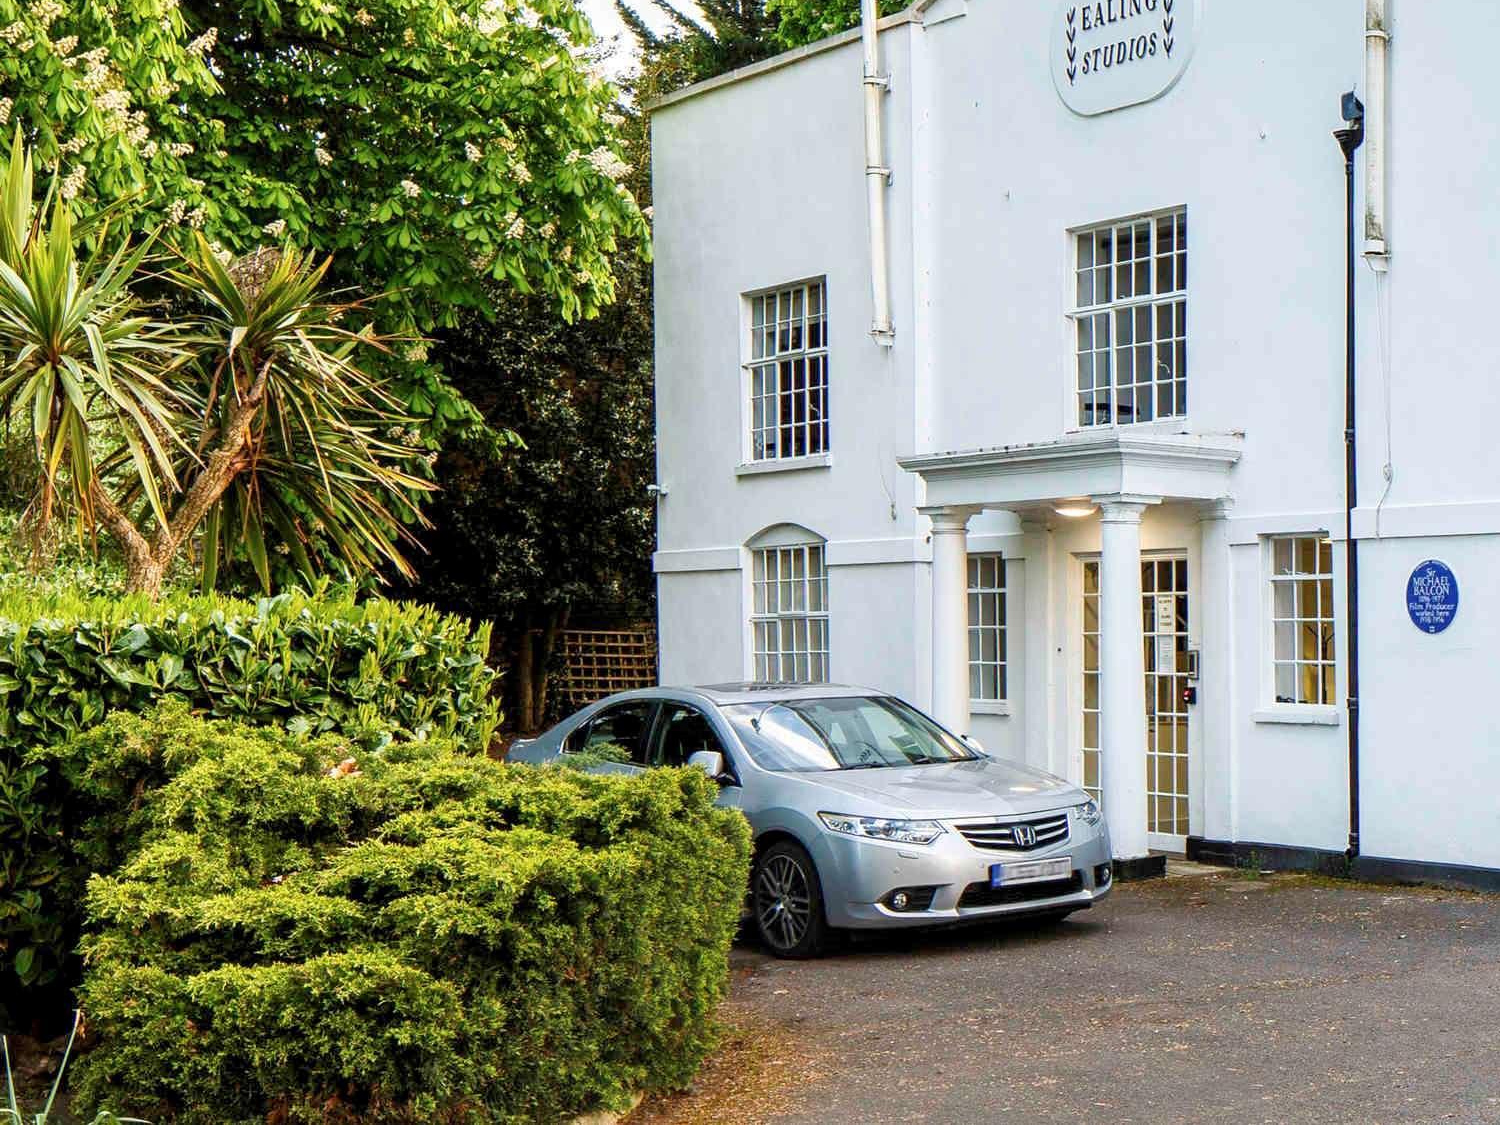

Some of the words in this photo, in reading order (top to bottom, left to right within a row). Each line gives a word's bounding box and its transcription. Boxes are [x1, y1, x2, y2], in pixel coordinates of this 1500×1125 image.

[1082, 32, 1157, 74] STUDIOS
[1413, 577, 1450, 586] MICHAEL
[1413, 586, 1450, 596] BALCON
